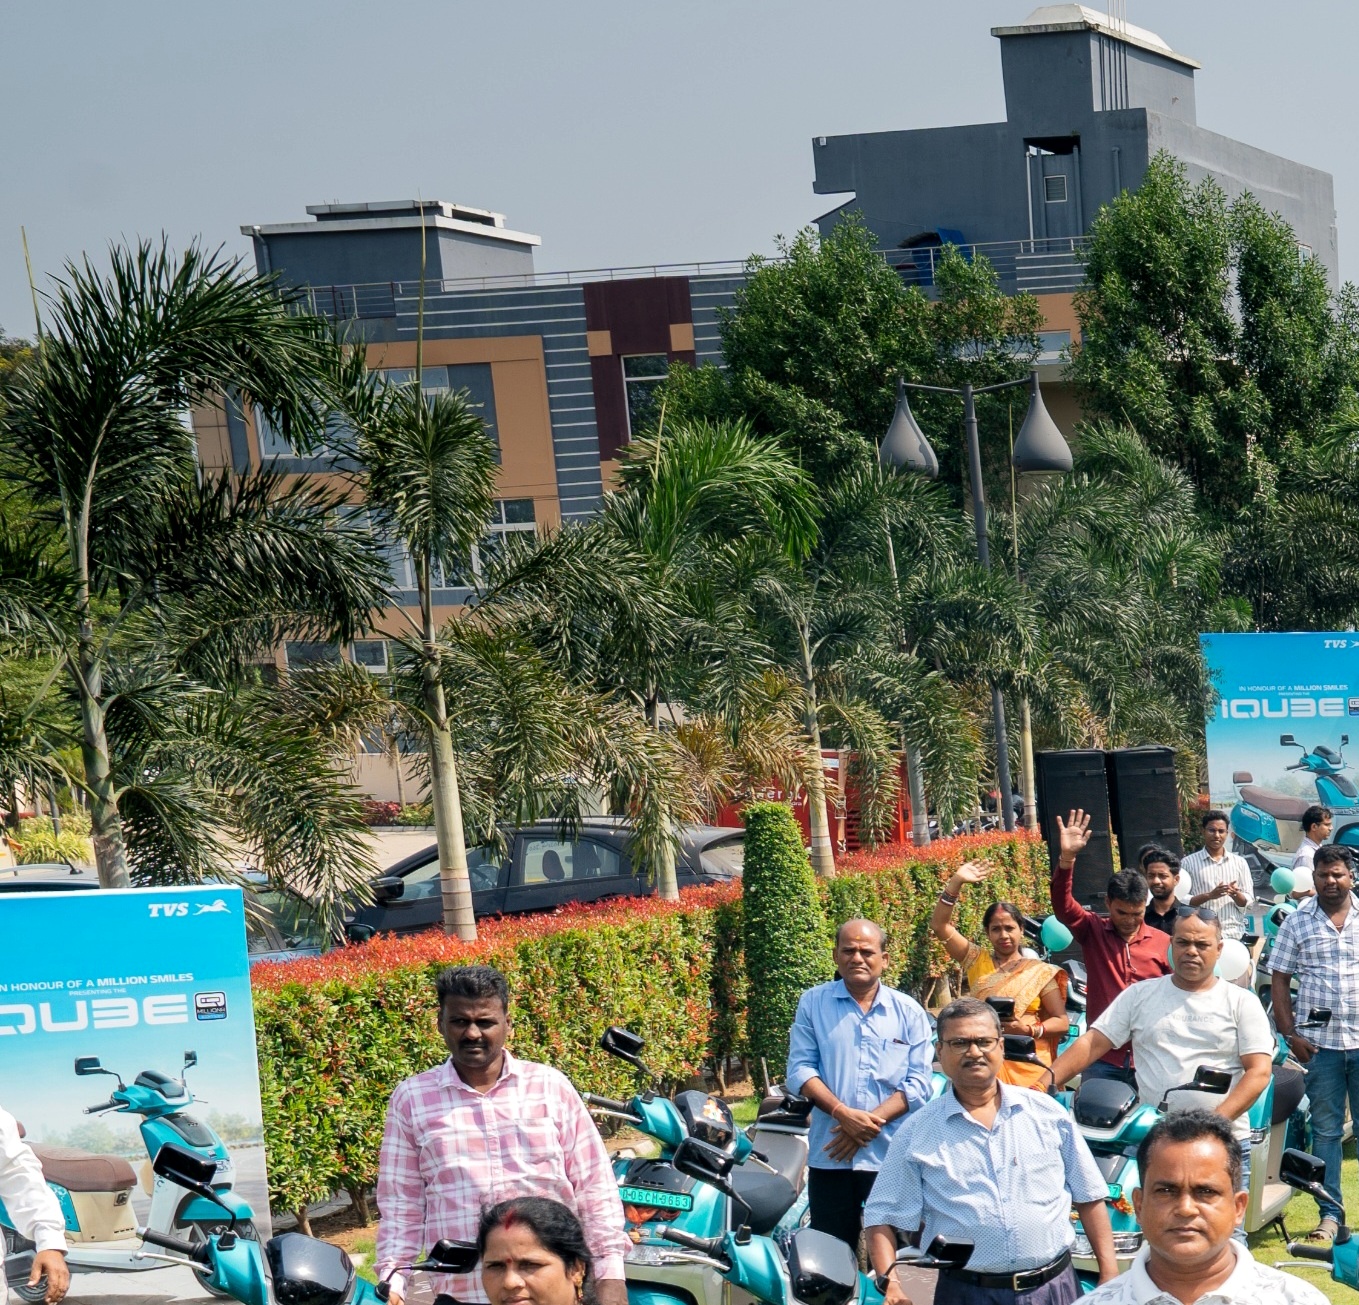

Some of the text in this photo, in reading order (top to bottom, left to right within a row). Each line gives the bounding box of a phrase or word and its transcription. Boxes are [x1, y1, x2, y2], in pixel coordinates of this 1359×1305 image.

[1324, 640, 1347, 648] TVS
[149, 903, 189, 918] TVS
[11, 981, 64, 991] HONOUR
[67, 980, 82, 988] OF
[86, 979, 95, 987] A
[97, 975, 147, 986] MILLION
[150, 973, 193, 983] SMILES
[0, 994, 189, 1035] QUBE
